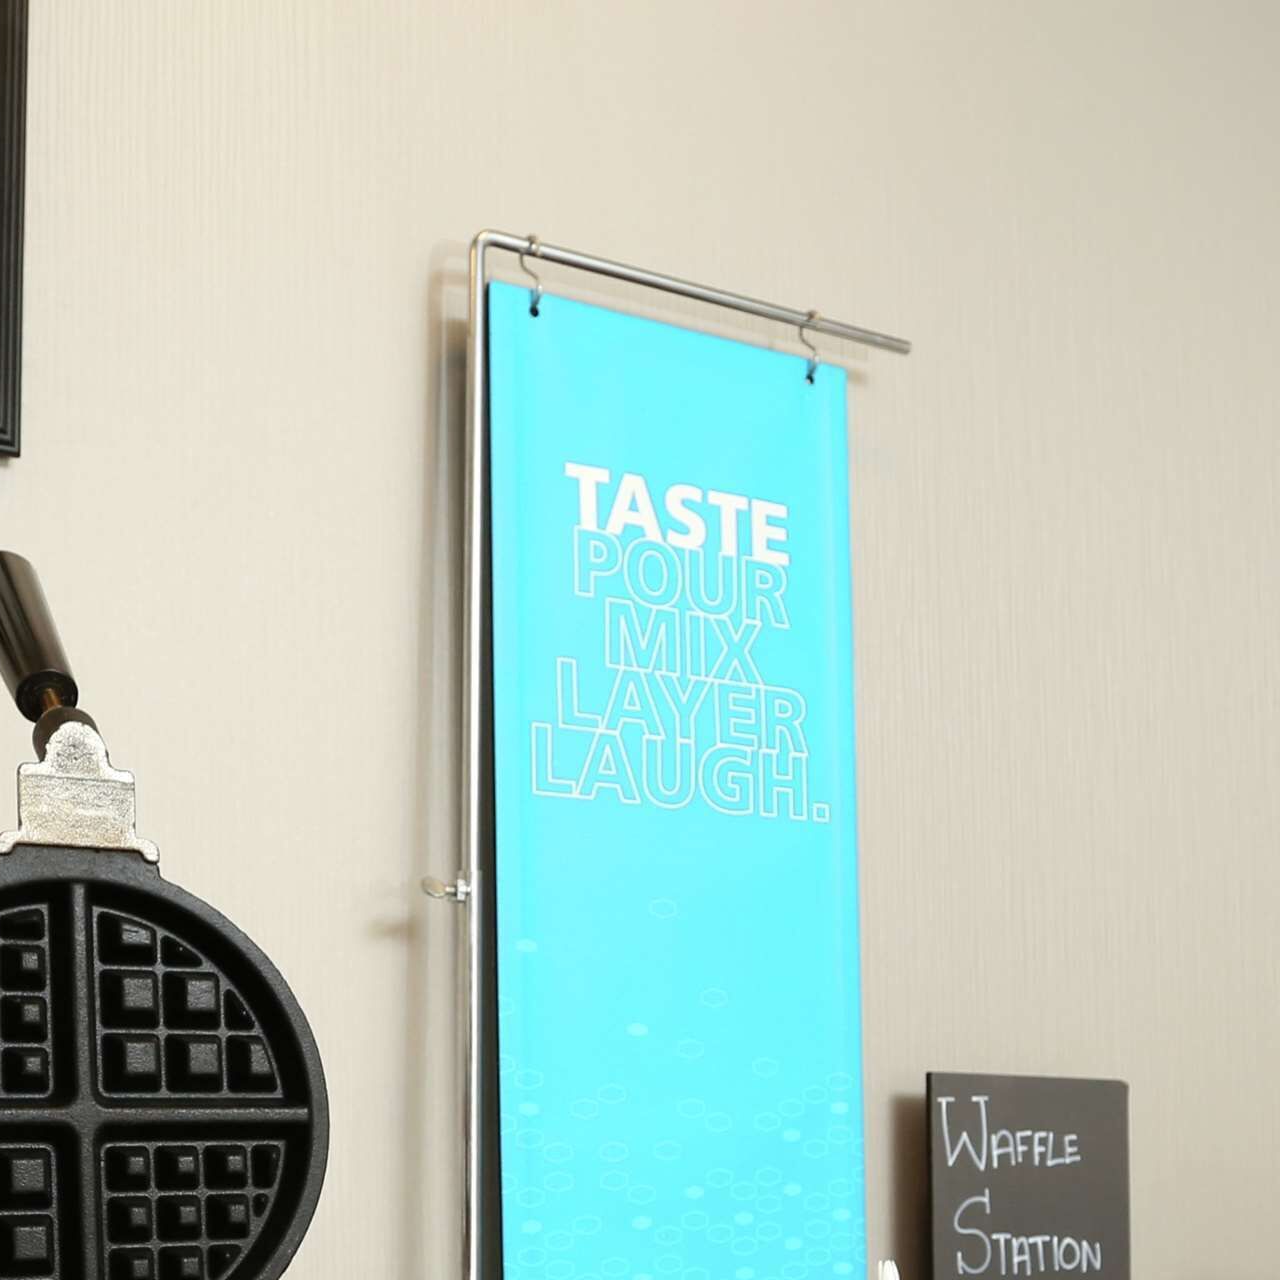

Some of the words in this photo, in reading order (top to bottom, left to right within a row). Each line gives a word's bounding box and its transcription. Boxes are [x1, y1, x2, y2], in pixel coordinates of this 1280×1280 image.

[564, 461, 790, 567] TASTE
[573, 525, 791, 629] POUR
[605, 597, 765, 688] MIX
[556, 656, 809, 757] LAYER
[531, 721, 831, 823] LAUGH.
